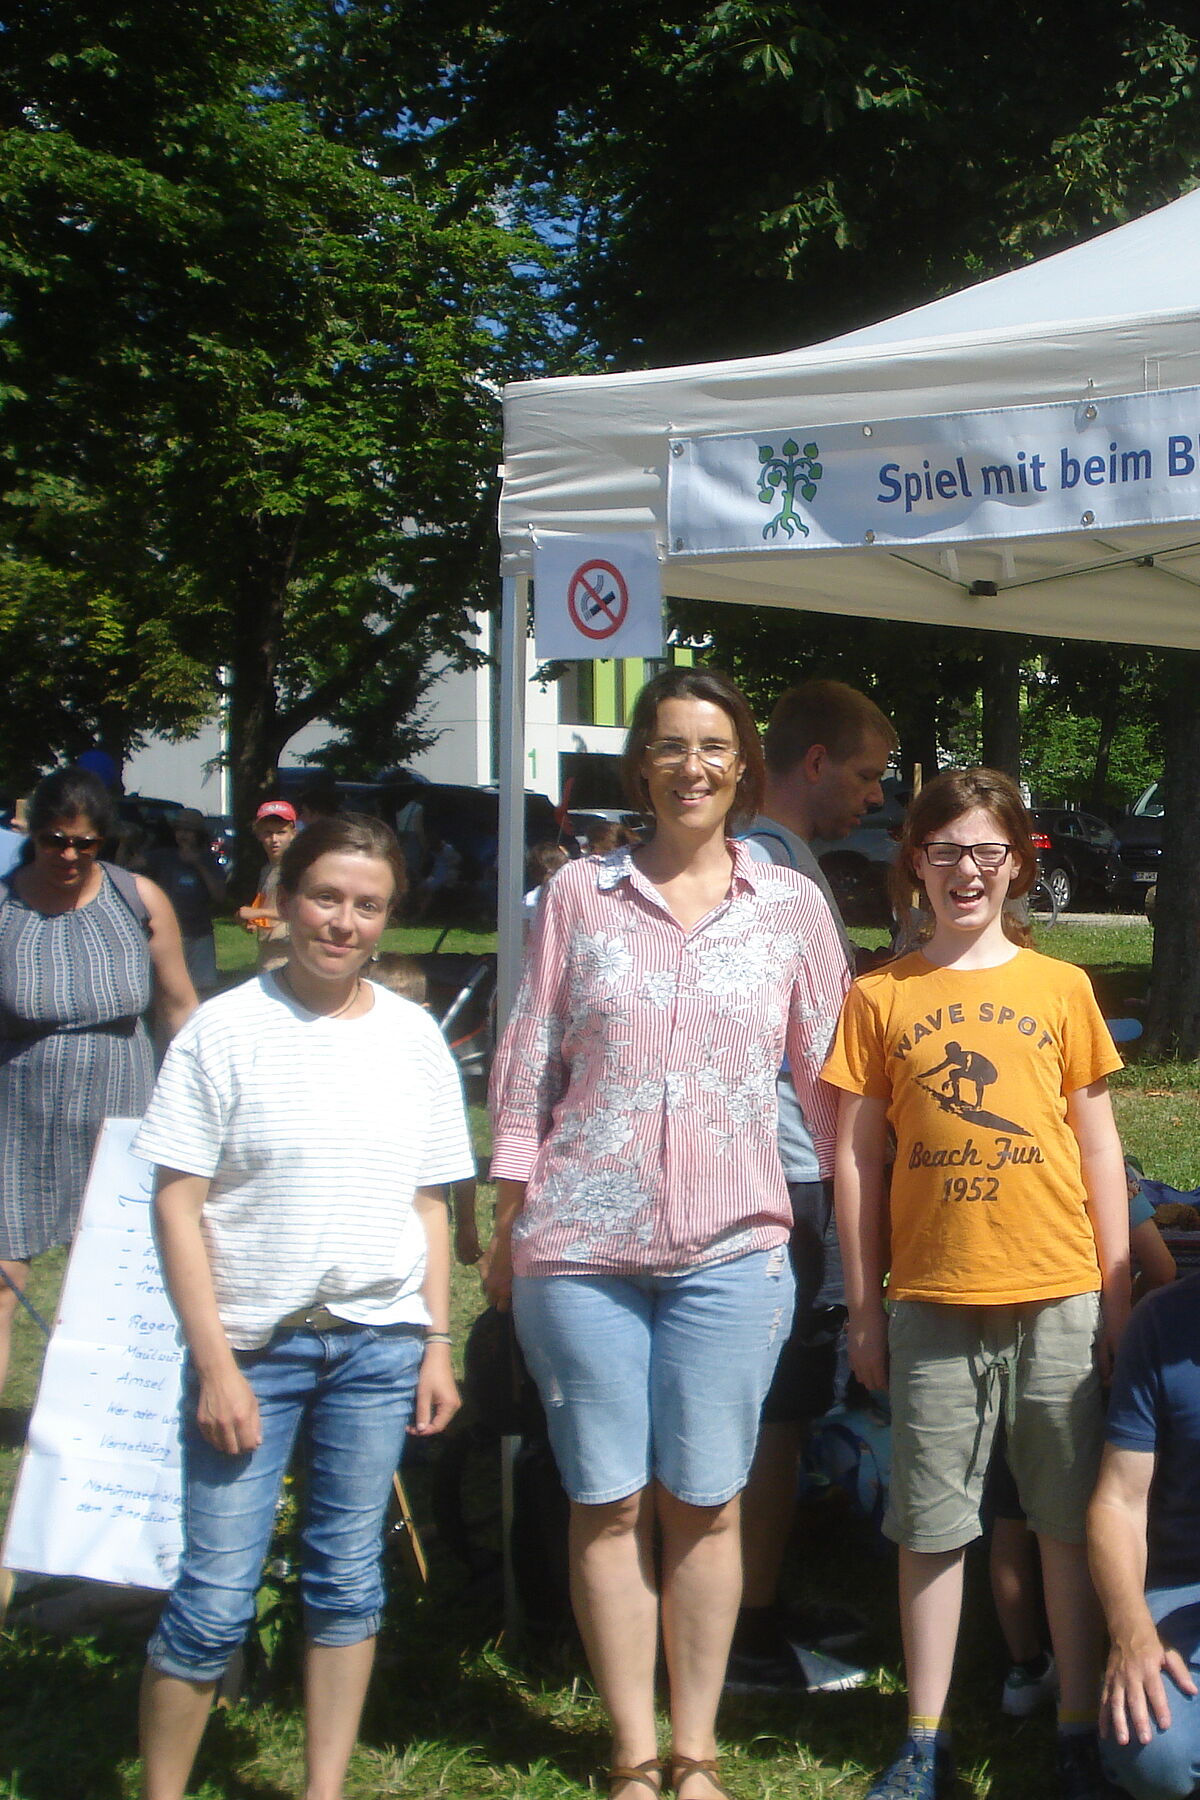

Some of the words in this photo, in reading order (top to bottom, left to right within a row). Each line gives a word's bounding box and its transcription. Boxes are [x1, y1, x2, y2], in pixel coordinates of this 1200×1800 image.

[877, 456, 972, 513] Spiel
[981, 451, 1048, 495] mit
[1060, 442, 1152, 489] beim
[893, 1003, 965, 1061] WAVE
[979, 1002, 1053, 1049] SPOT
[908, 1138, 983, 1170] Beach
[987, 1137, 1045, 1171] Fun
[943, 1176, 1000, 1202] 1952
[115, 1372, 166, 1391] Amsel
